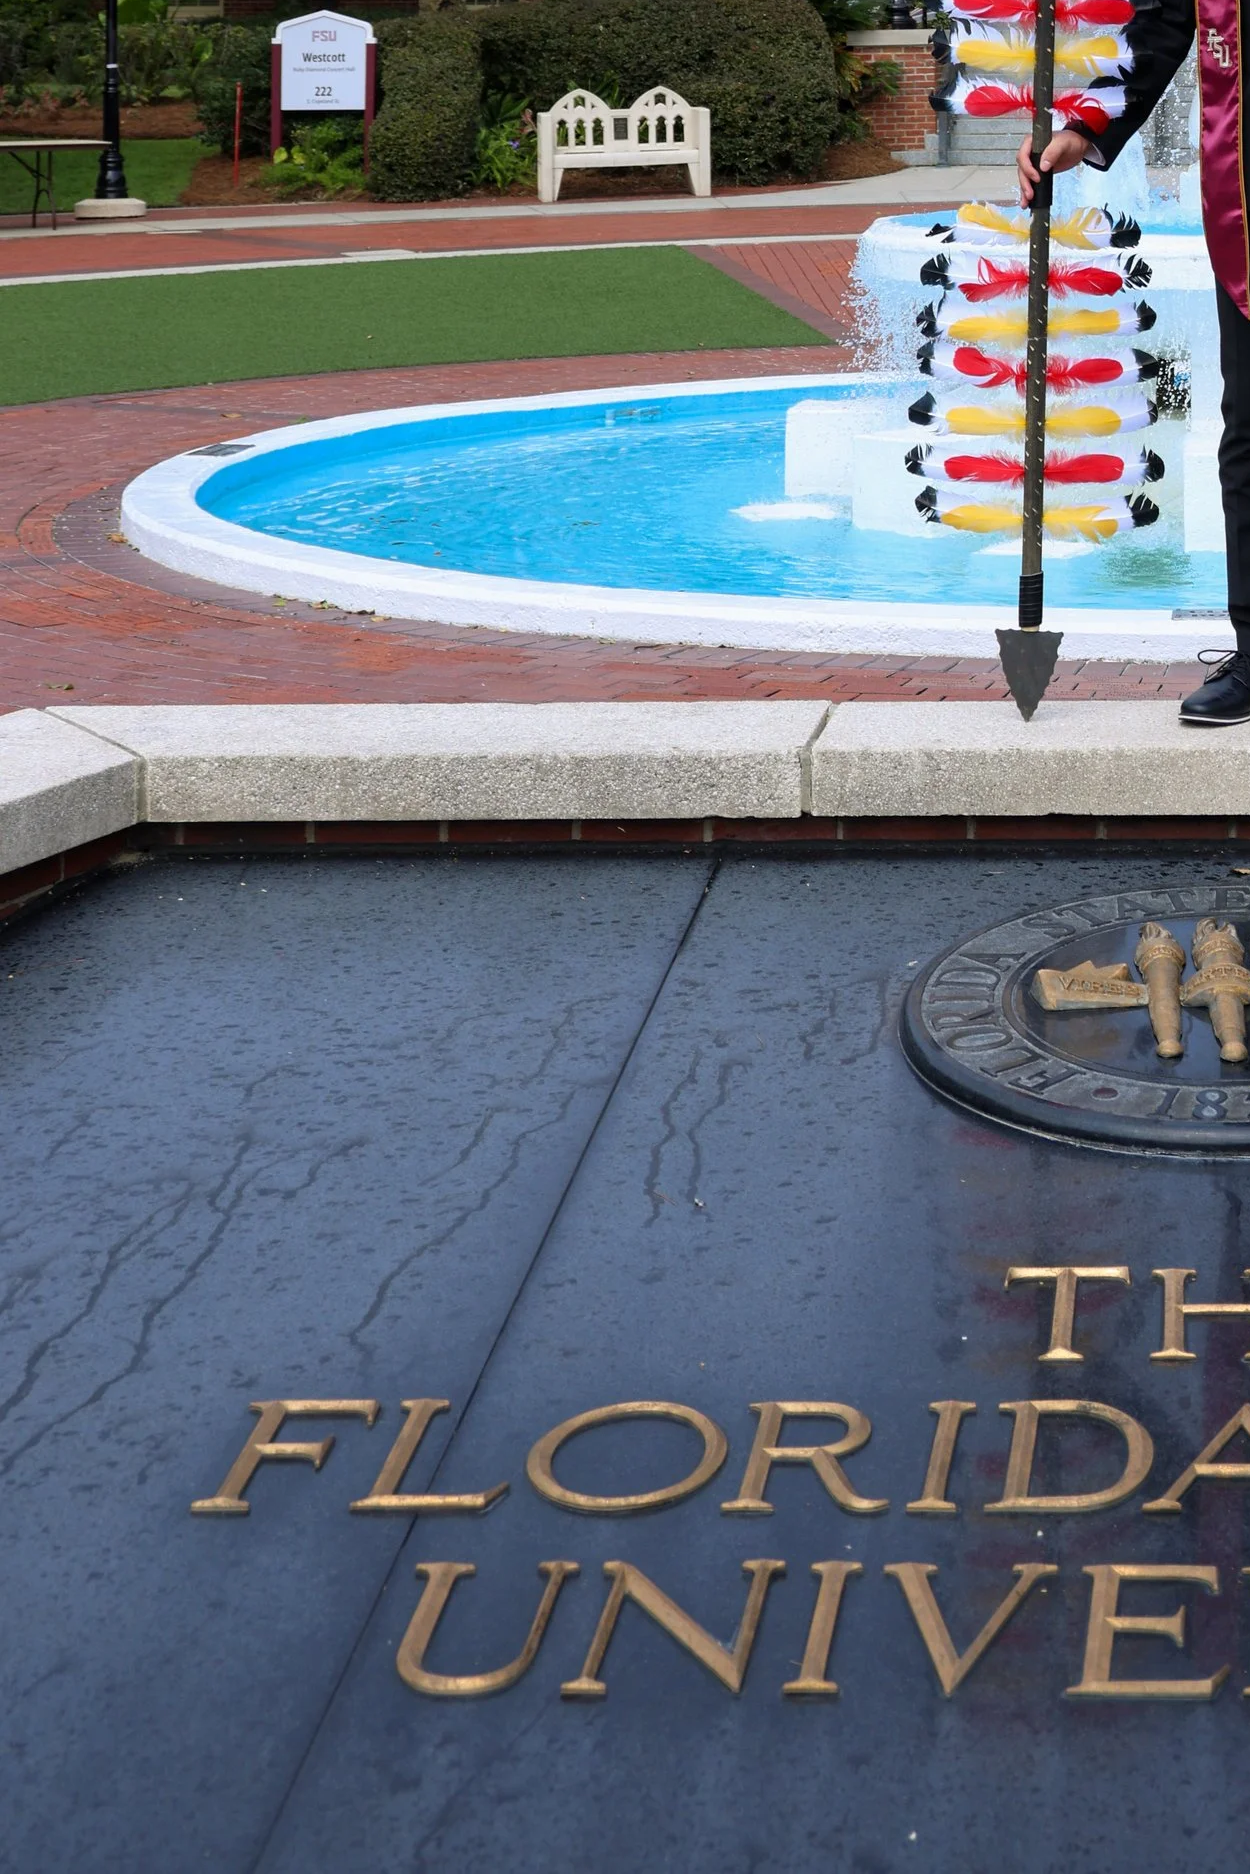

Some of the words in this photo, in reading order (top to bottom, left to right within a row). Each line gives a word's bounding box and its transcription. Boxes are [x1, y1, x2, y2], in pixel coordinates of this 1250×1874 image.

[312, 30, 337, 42] FSU
[1207, 28, 1233, 68] FSU
[302, 52, 346, 63] Westcott
[315, 86, 332, 97] 222
[1058, 975, 1142, 998] VIRES
[930, 950, 1076, 1095] FLORIDA
